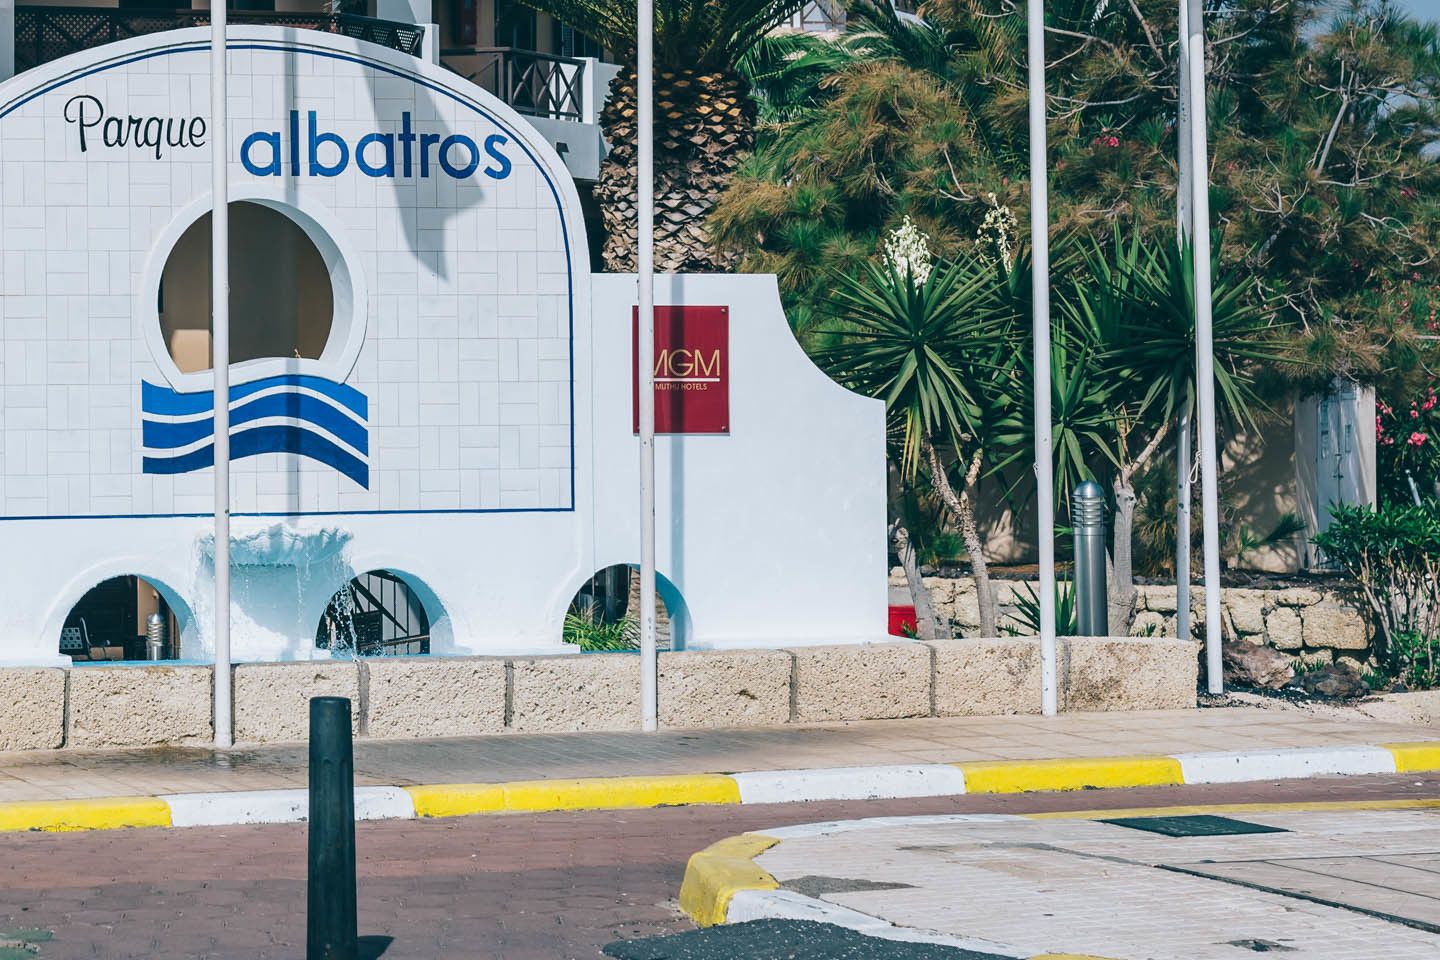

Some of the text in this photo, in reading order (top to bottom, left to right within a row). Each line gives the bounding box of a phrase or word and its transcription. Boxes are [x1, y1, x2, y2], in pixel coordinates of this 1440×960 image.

[63, 95, 513, 180] Parque albatros
[681, 383, 708, 391] HOTELS
